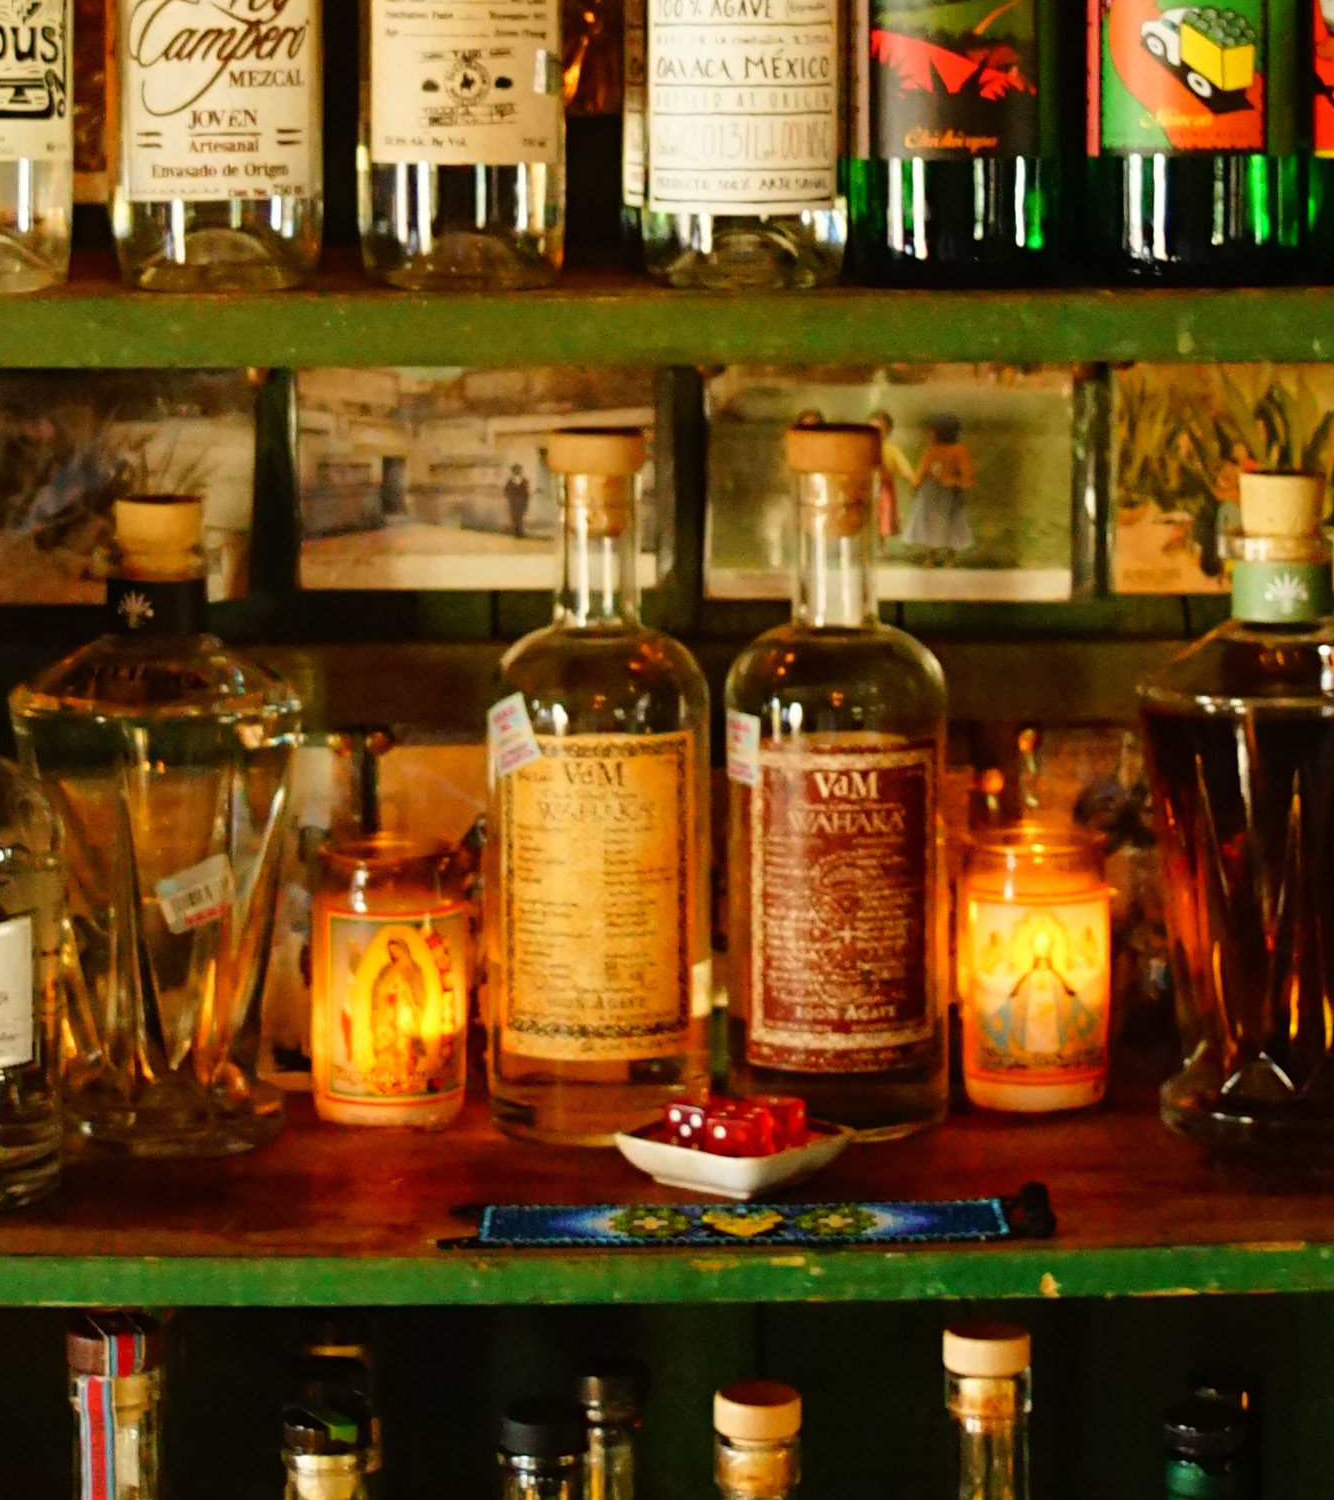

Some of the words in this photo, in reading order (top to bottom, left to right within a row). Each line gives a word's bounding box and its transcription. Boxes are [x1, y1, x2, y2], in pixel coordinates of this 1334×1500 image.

[744, 48, 829, 79] MÉXICO
[229, 70, 302, 88] MEZCAL
[188, 109, 257, 129] JOVEN
[188, 138, 260, 153] Artesanal
[151, 164, 216, 179] Envasado
[223, 163, 239, 176] de
[814, 771, 879, 800] VdM
[788, 808, 904, 834] WAHAKA
